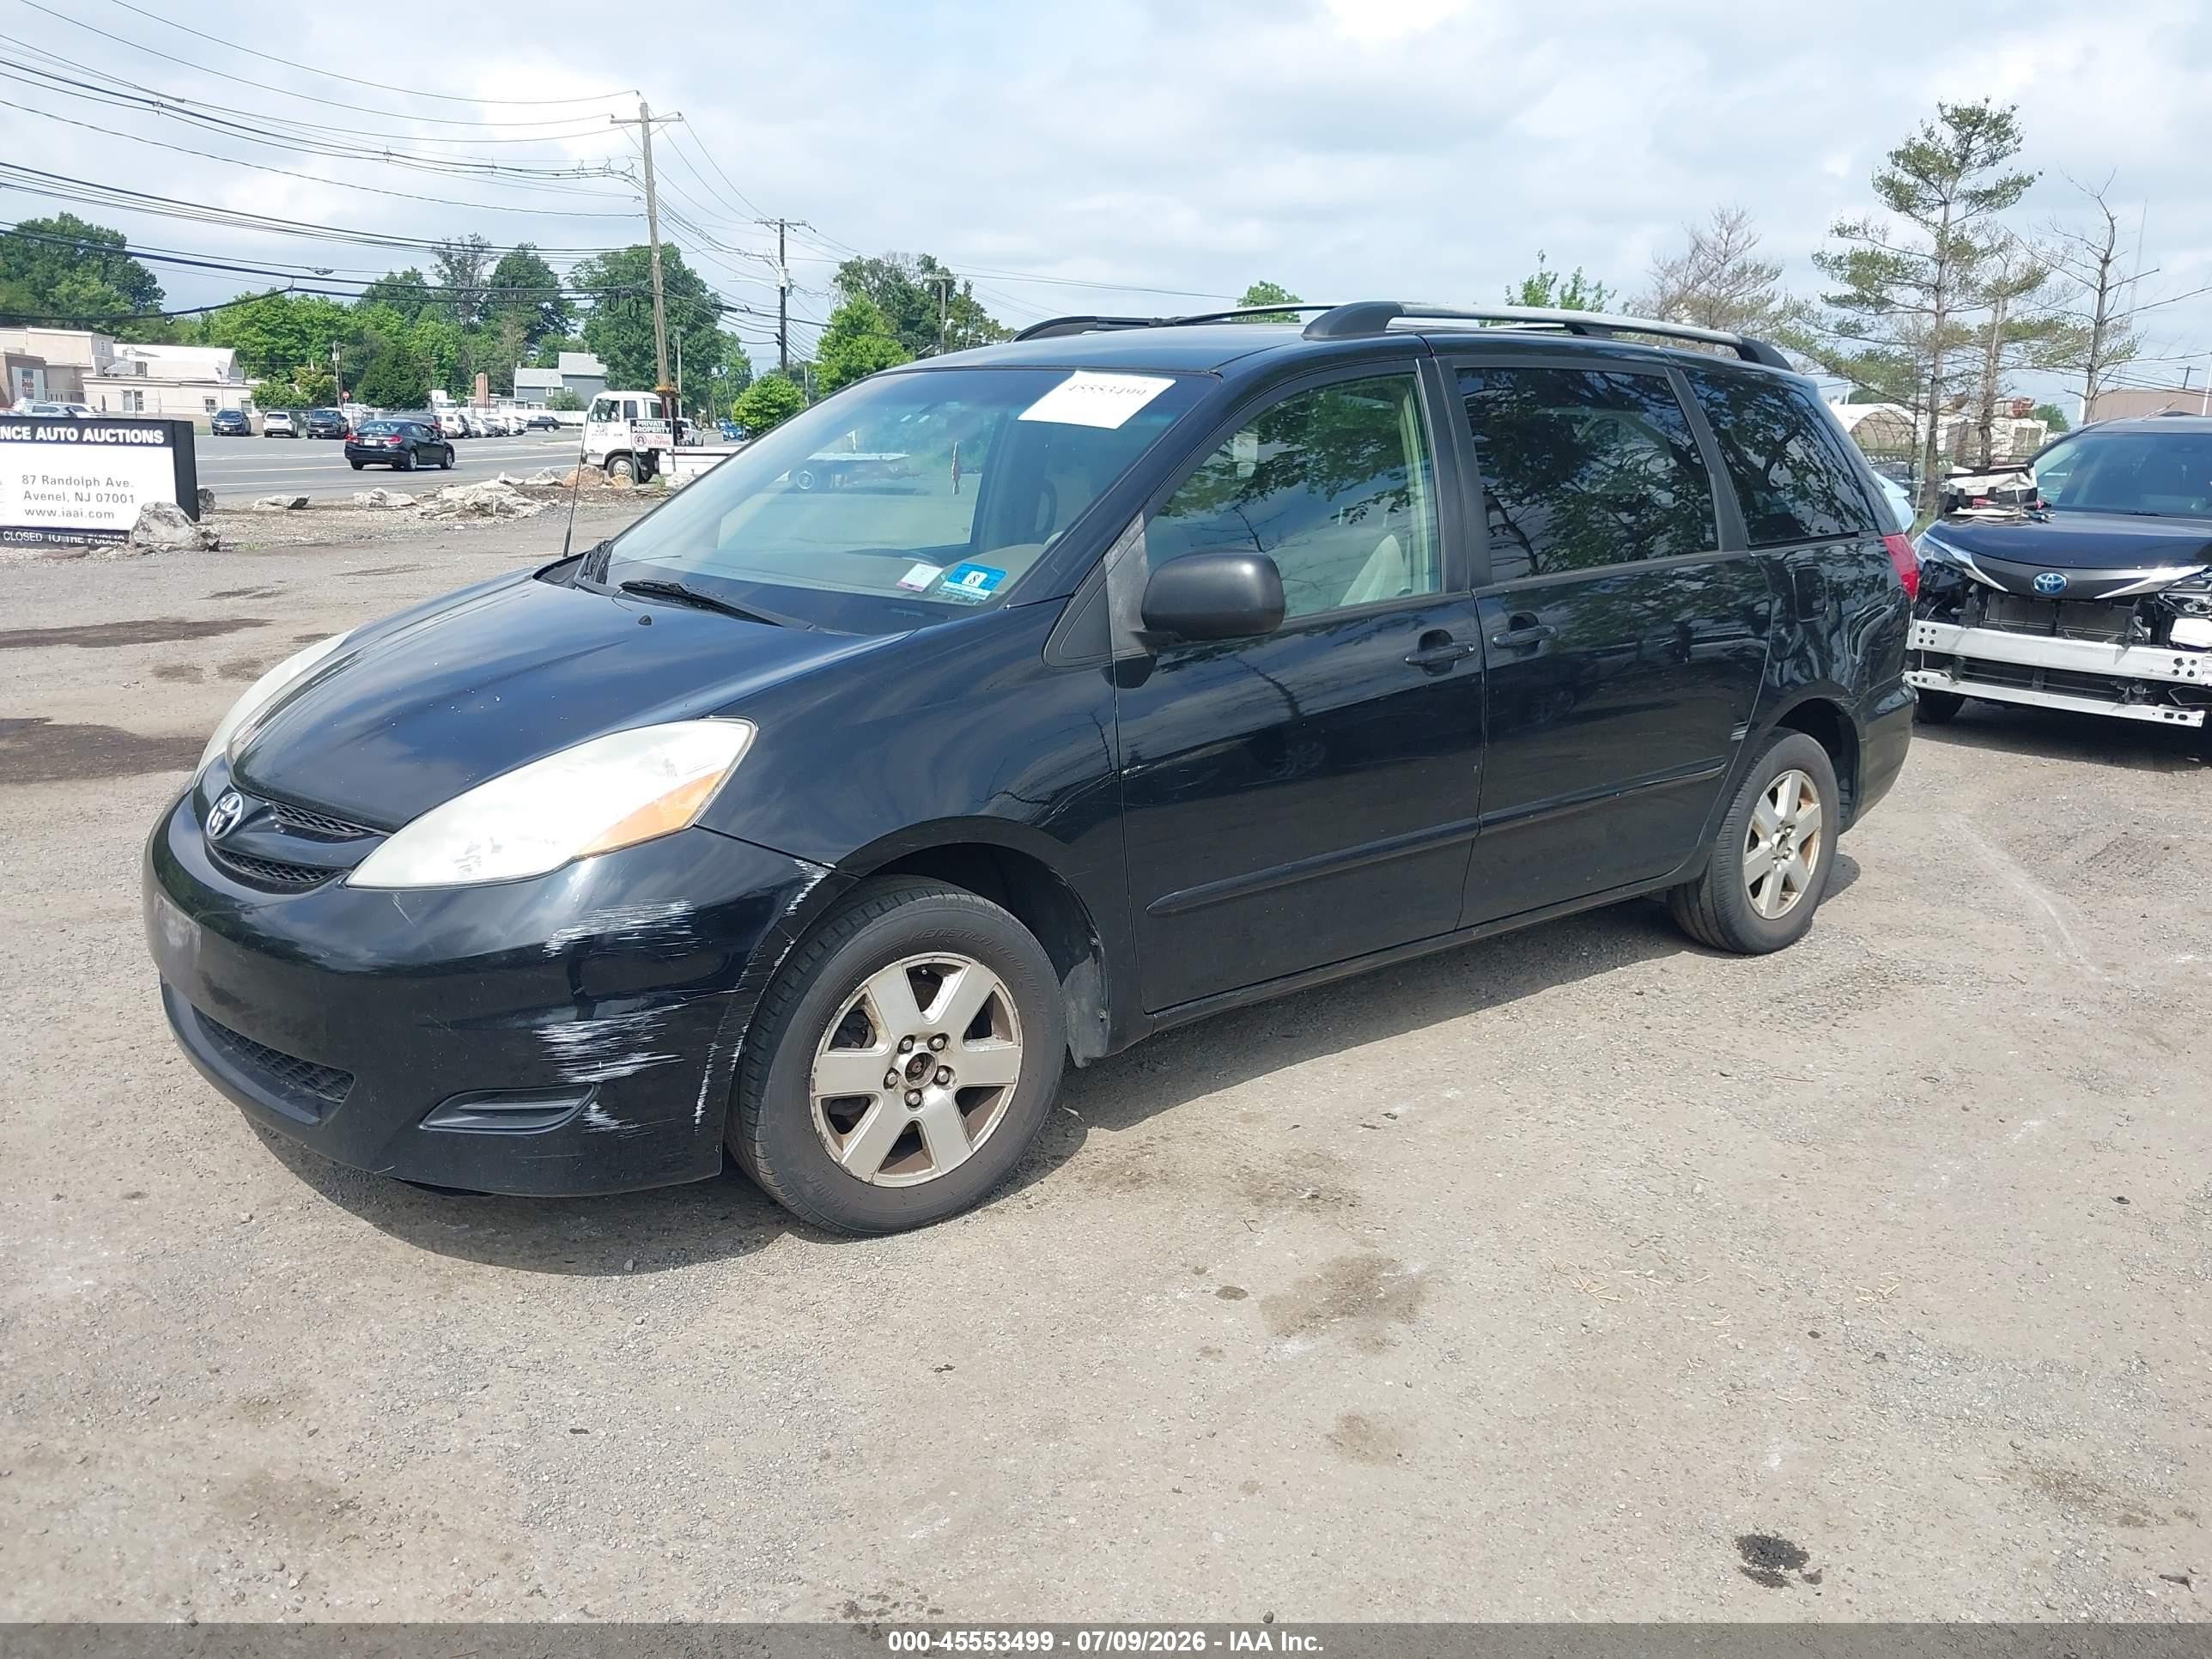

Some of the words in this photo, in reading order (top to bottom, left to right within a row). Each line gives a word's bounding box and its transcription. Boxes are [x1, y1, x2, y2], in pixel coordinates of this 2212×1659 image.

[35, 427, 79, 441] AUTO
[82, 428, 165, 445] AUCTIONS
[21, 475, 37, 485] 87
[42, 475, 100, 489] Randolph
[106, 477, 134, 488] Ave.
[23, 490, 70, 502] Avenel,
[75, 492, 91, 502] NJ
[96, 493, 135, 503] 07001
[24, 507, 115, 519] www.iaai.com
[3, 531, 43, 542] CLOSED
[48, 533, 61, 543] TO
[65, 534, 85, 544] THE
[968, 574, 981, 585] 8
